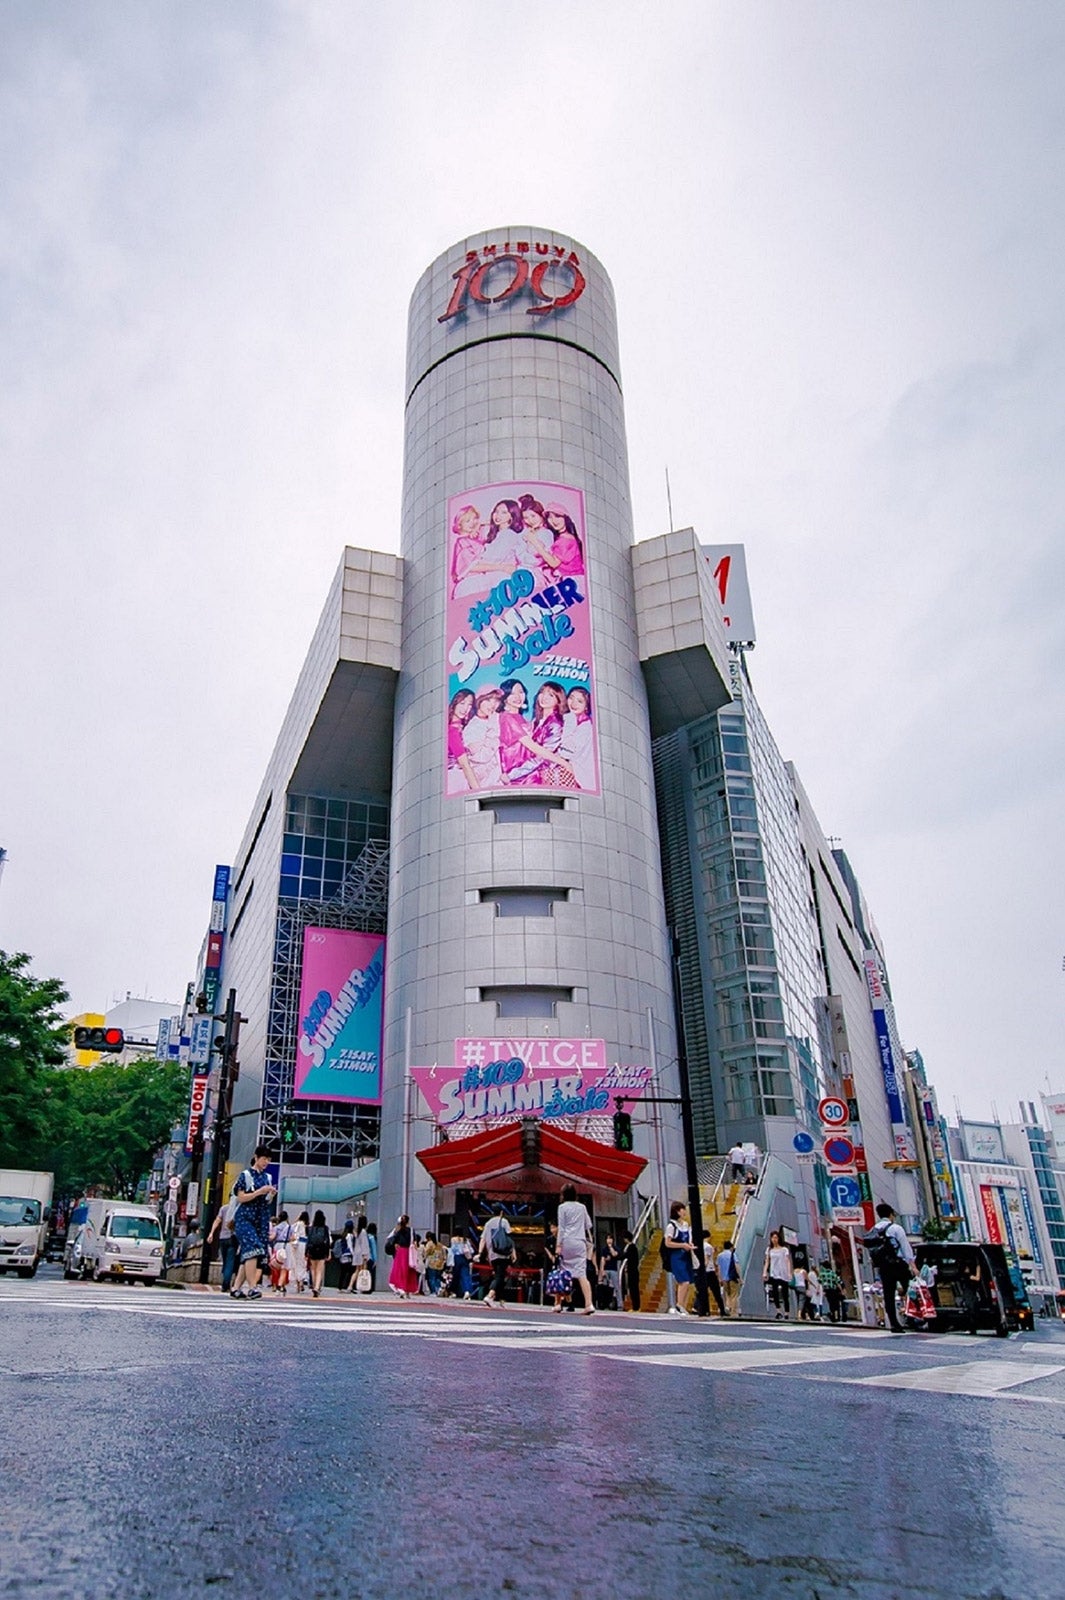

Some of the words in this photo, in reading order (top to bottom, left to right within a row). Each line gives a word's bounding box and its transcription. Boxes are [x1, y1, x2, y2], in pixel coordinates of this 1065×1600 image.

[465, 241, 580, 266] SHIBUYA
[437, 253, 586, 324] 109
[467, 568, 535, 633] #109
[448, 577, 585, 683] SUMMER
[498, 613, 576, 677] Sale
[299, 968, 367, 1068] SUMMER
[462, 1040, 599, 1067] #TWICE
[462, 1057, 525, 1092] #109
[437, 1076, 583, 1125] SUMMER
[540, 1086, 610, 1119] Sale
[825, 1105, 842, 1119] 30
[836, 1184, 849, 1204] P
